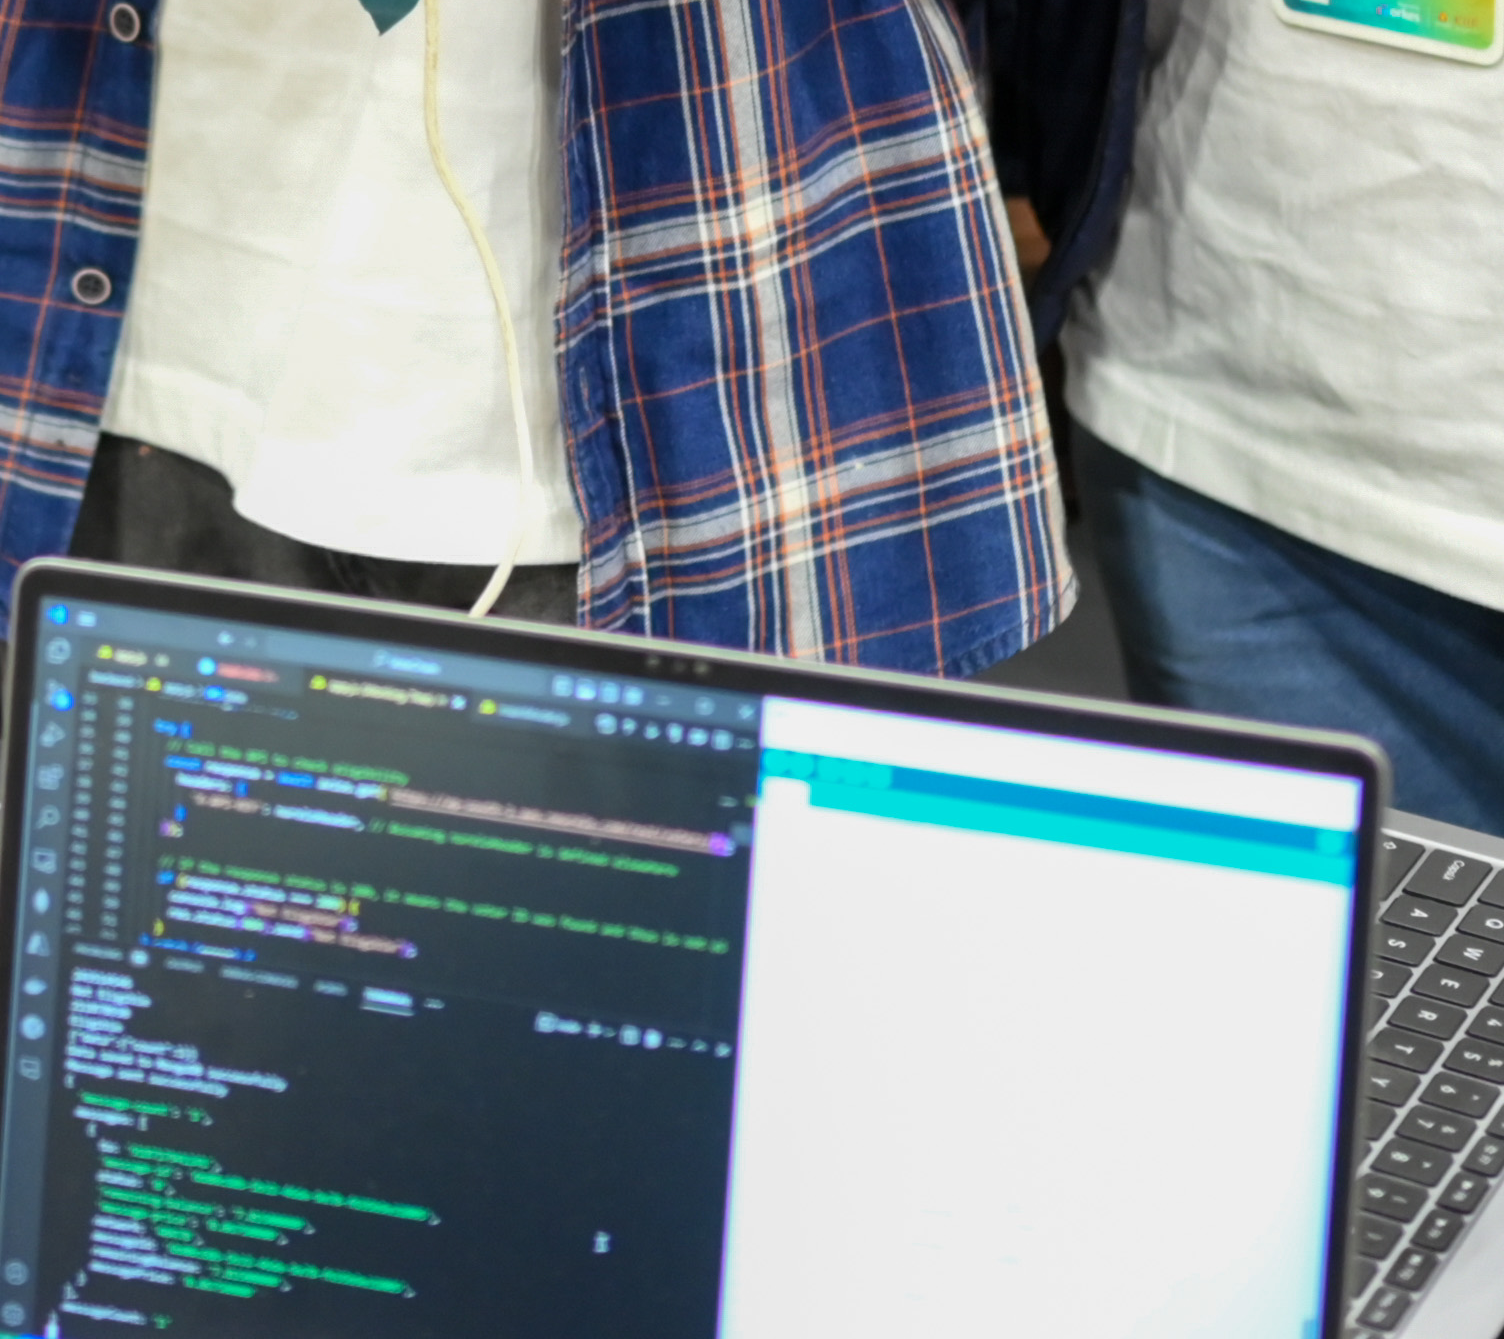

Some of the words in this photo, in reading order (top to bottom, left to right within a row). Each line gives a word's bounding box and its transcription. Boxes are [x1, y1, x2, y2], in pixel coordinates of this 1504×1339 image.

[1409, 908, 1429, 919] A
[1485, 919, 1504, 930] Q
[1463, 947, 1484, 961] W
[1440, 978, 1460, 989] E
[1417, 1009, 1438, 1021] R
[1394, 1044, 1414, 1055] T
[1371, 1077, 1390, 1088] Y
